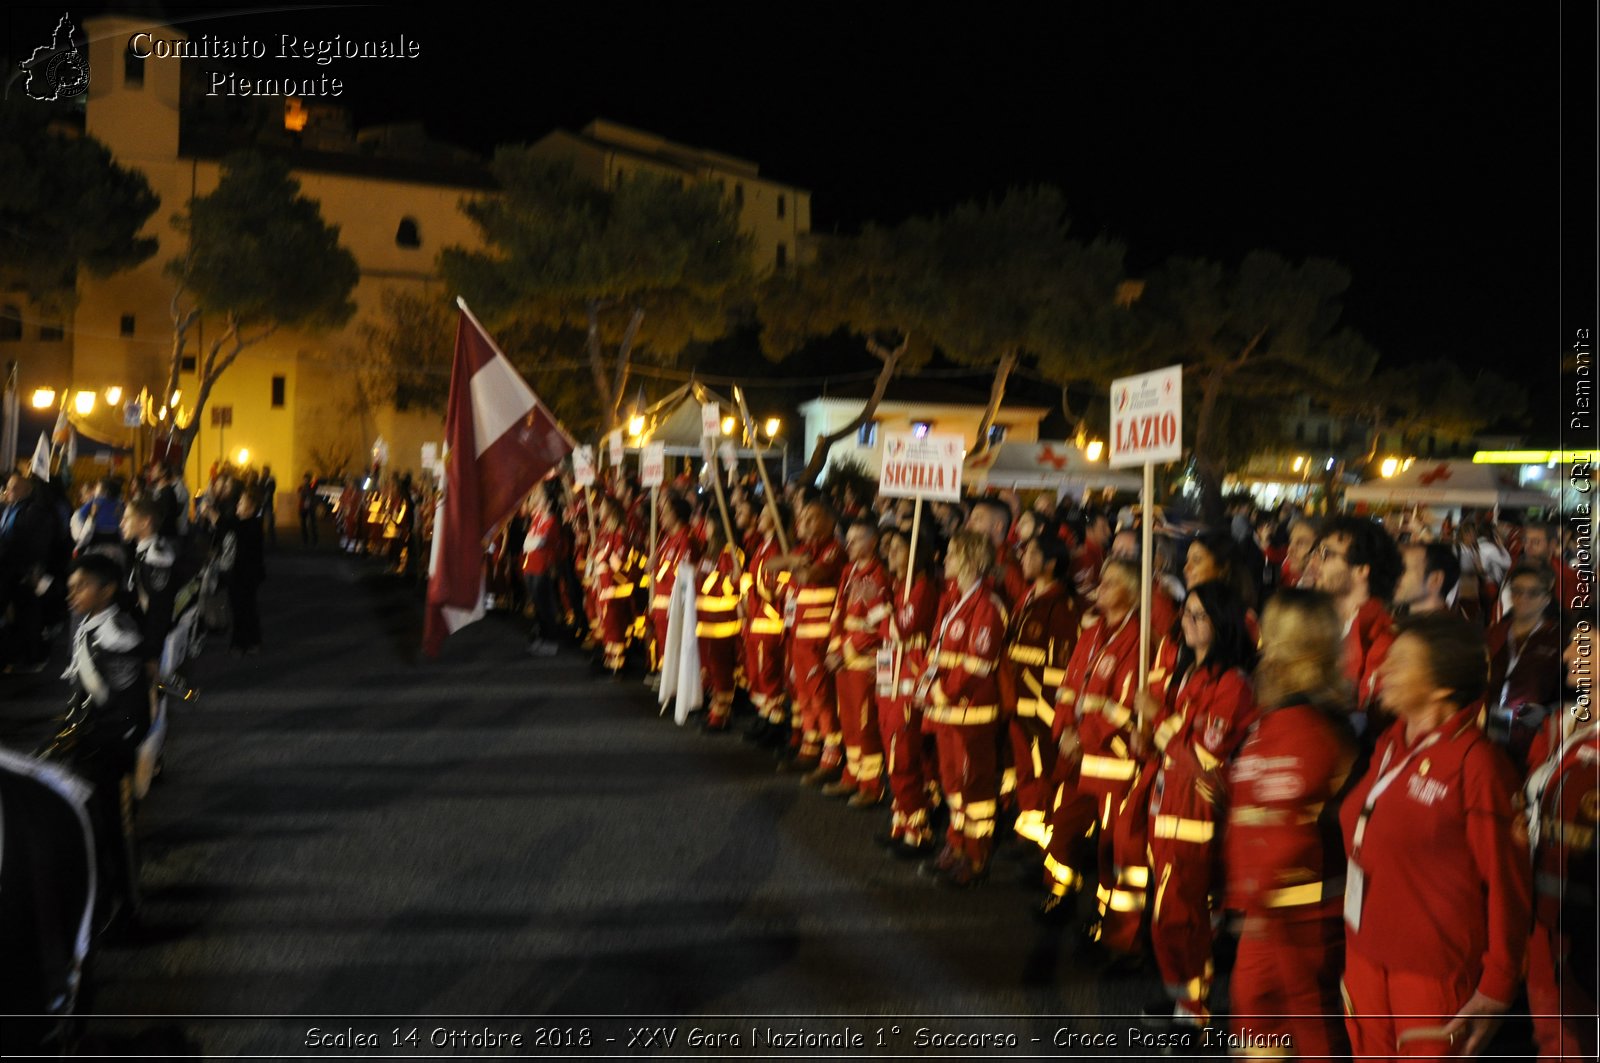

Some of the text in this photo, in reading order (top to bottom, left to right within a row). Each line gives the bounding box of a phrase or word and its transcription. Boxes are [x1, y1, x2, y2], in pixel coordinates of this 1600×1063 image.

[1115, 410, 1177, 453] LAZIO
[884, 460, 957, 491] SICILIA 1
